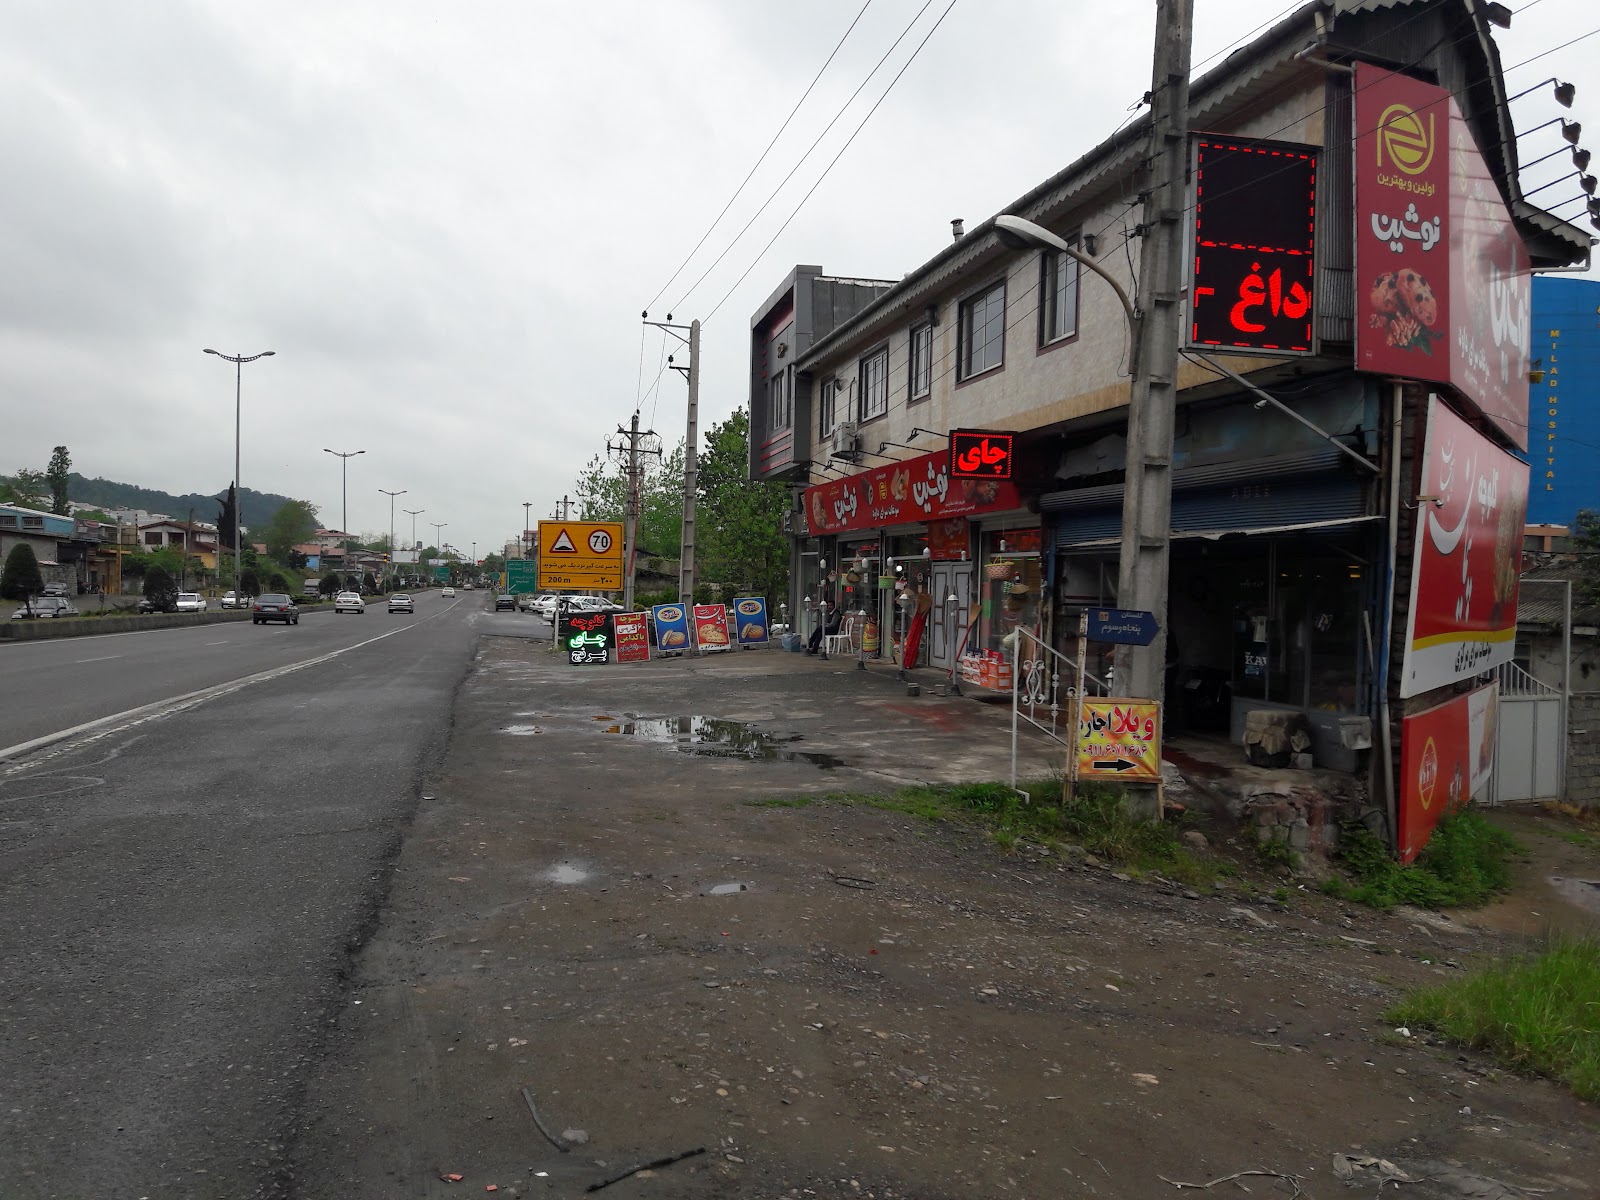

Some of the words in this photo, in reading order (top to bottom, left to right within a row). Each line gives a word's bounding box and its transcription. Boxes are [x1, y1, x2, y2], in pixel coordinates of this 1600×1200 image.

[1377, 172, 1407, 190] بهترین
[1413, 182, 1435, 197] اولین
[1371, 203, 1441, 253] نوشین
[1230, 262, 1308, 333] داغ
[1549, 329, 1560, 388] MILAD
[1546, 396, 1558, 491] HOSPITAL
[957, 439, 1008, 474] چای
[912, 461, 949, 514] نوشین
[834, 484, 857, 526] نوشین
[592, 535, 609, 548] 70
[600, 576, 613, 584] ۲۰۰
[570, 614, 606, 631] کلوچه
[619, 613, 641, 624] کلوچه
[1101, 625, 1118, 634] سوم
[1122, 623, 1141, 636] پنجاه
[570, 631, 607, 648] چای
[571, 647, 607, 662] برنج
[1114, 706, 1155, 741] ویلا
